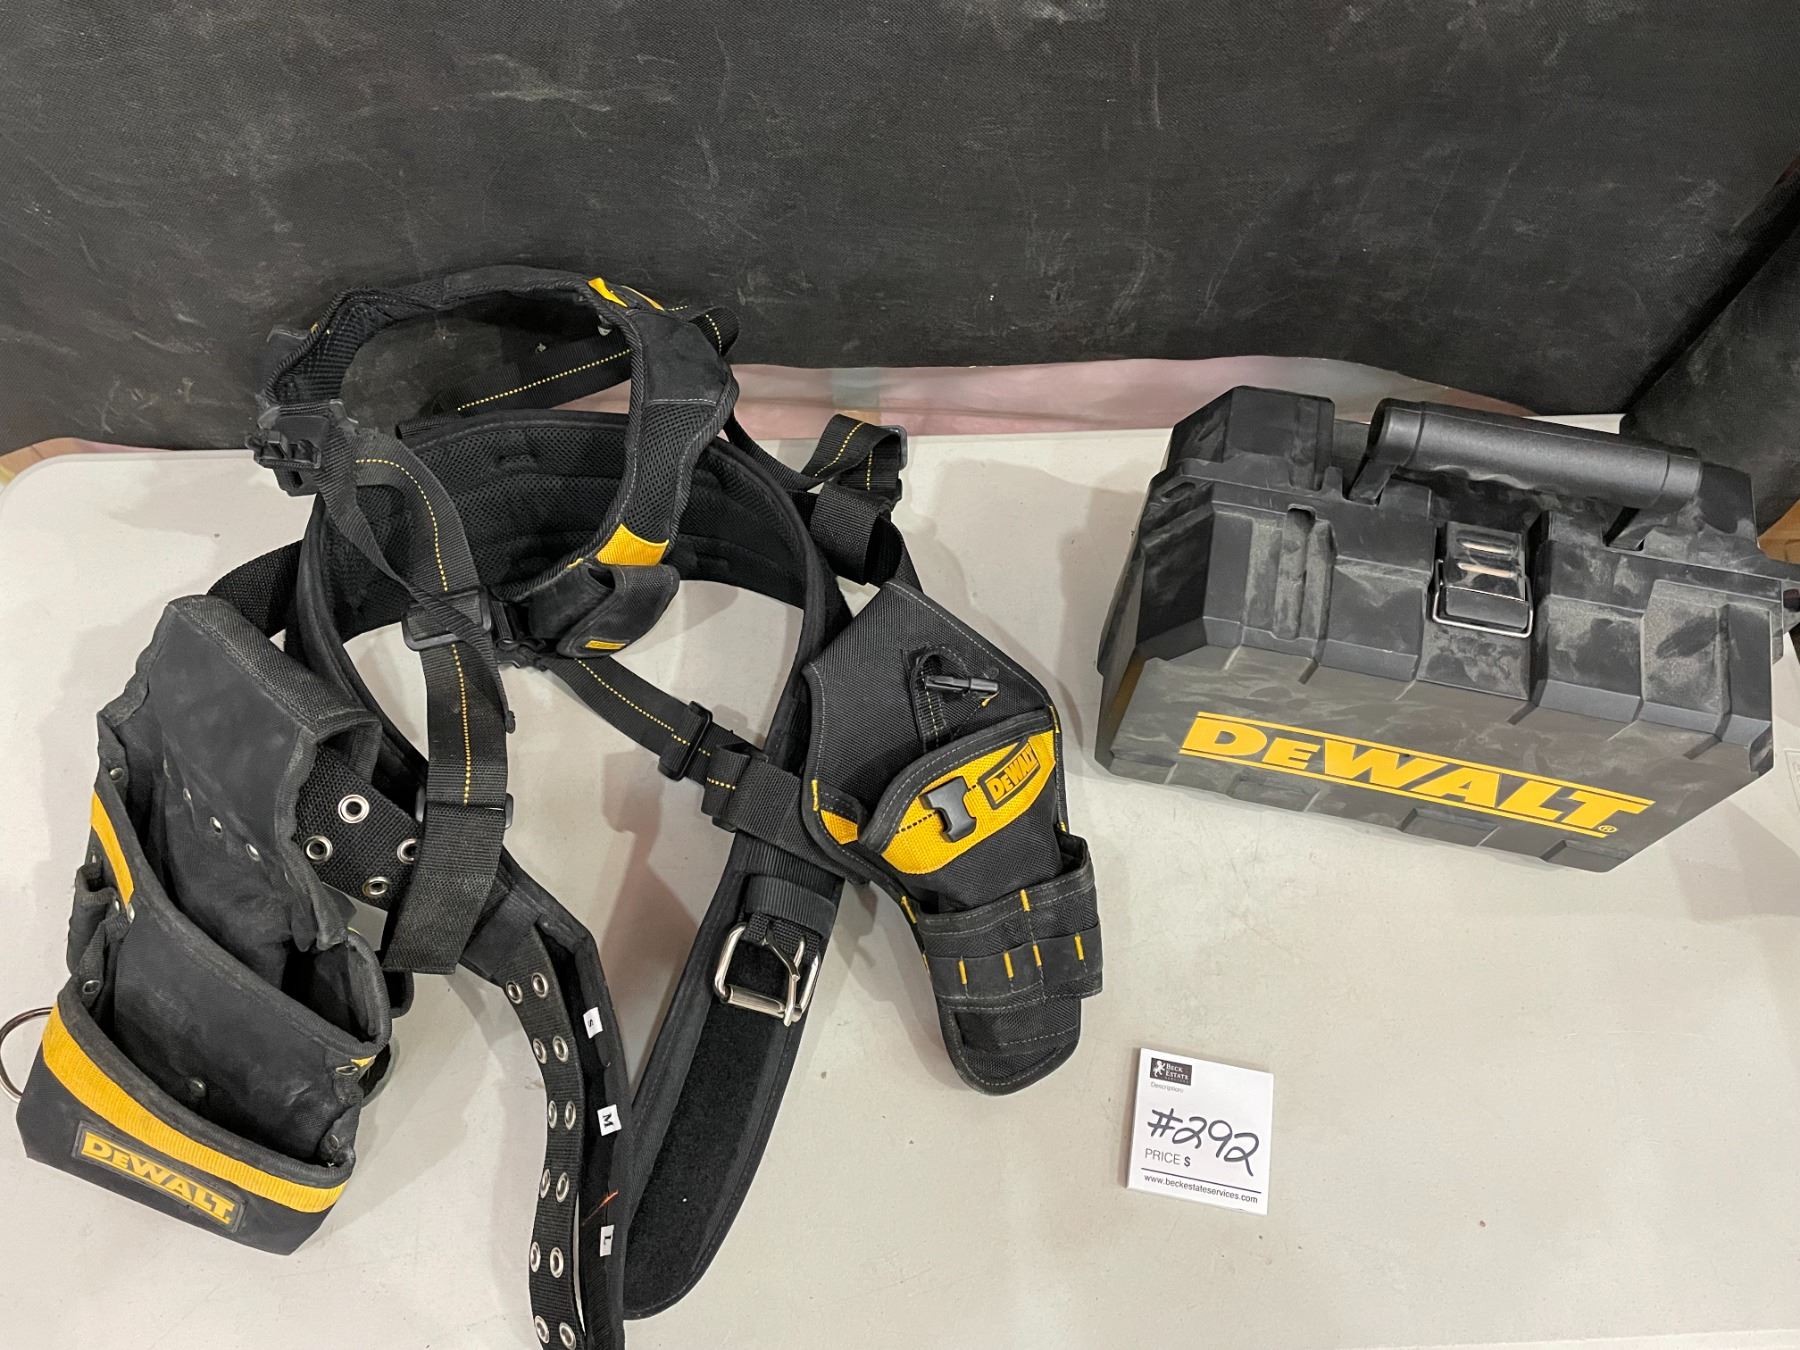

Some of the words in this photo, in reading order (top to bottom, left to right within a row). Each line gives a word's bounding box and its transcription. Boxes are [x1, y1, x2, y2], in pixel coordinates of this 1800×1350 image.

[984, 743, 1039, 802] DEWALT
[1181, 714, 1652, 834] DEWALT
[1165, 1070, 1189, 1080] ESTATE
[1166, 1062, 1183, 1073] BECK
[602, 1113, 614, 1128] M
[1144, 1148, 1181, 1166] PRICE
[1183, 1156, 1191, 1167] $
[1147, 1108, 1260, 1176] #292
[81, 1132, 235, 1223] DEWALT
[1143, 1173, 1259, 1204] www.beckestateservices.com
